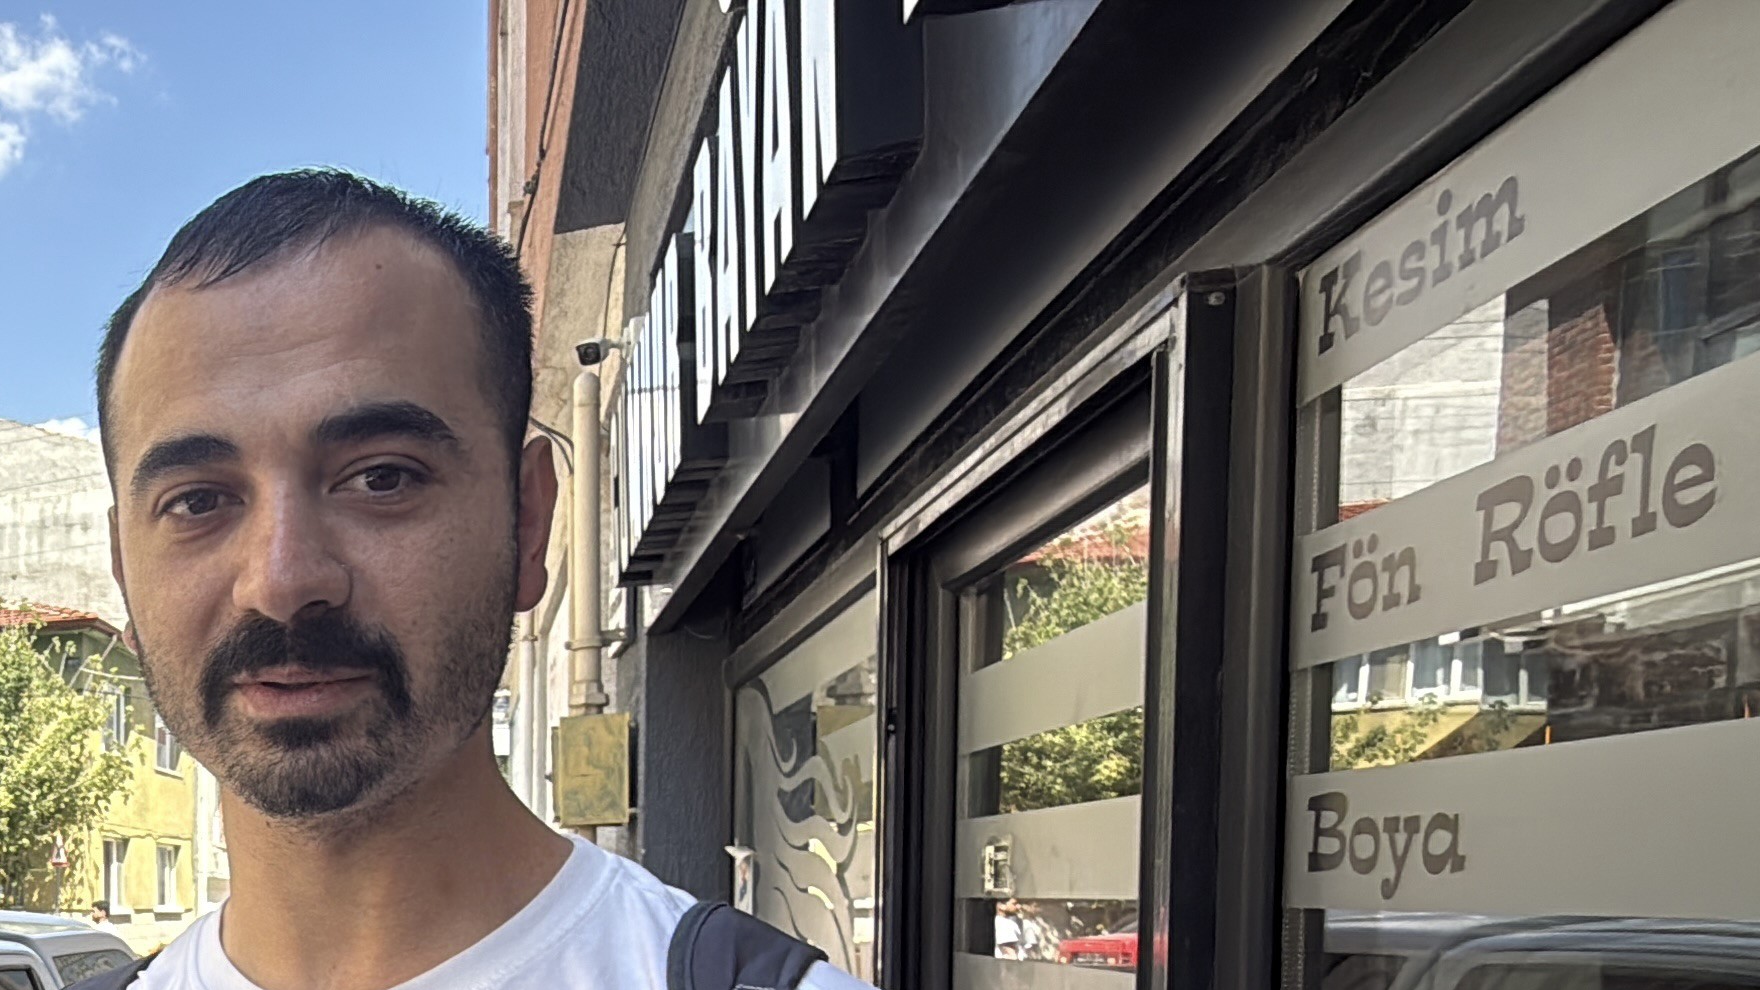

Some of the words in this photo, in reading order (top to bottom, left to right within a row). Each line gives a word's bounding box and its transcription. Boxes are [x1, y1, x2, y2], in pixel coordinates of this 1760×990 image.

[1318, 176, 1526, 357] Kesim
[1311, 533, 1422, 633] Fön
[1474, 424, 1719, 586] Röfle
[1307, 791, 1466, 900] Boya
